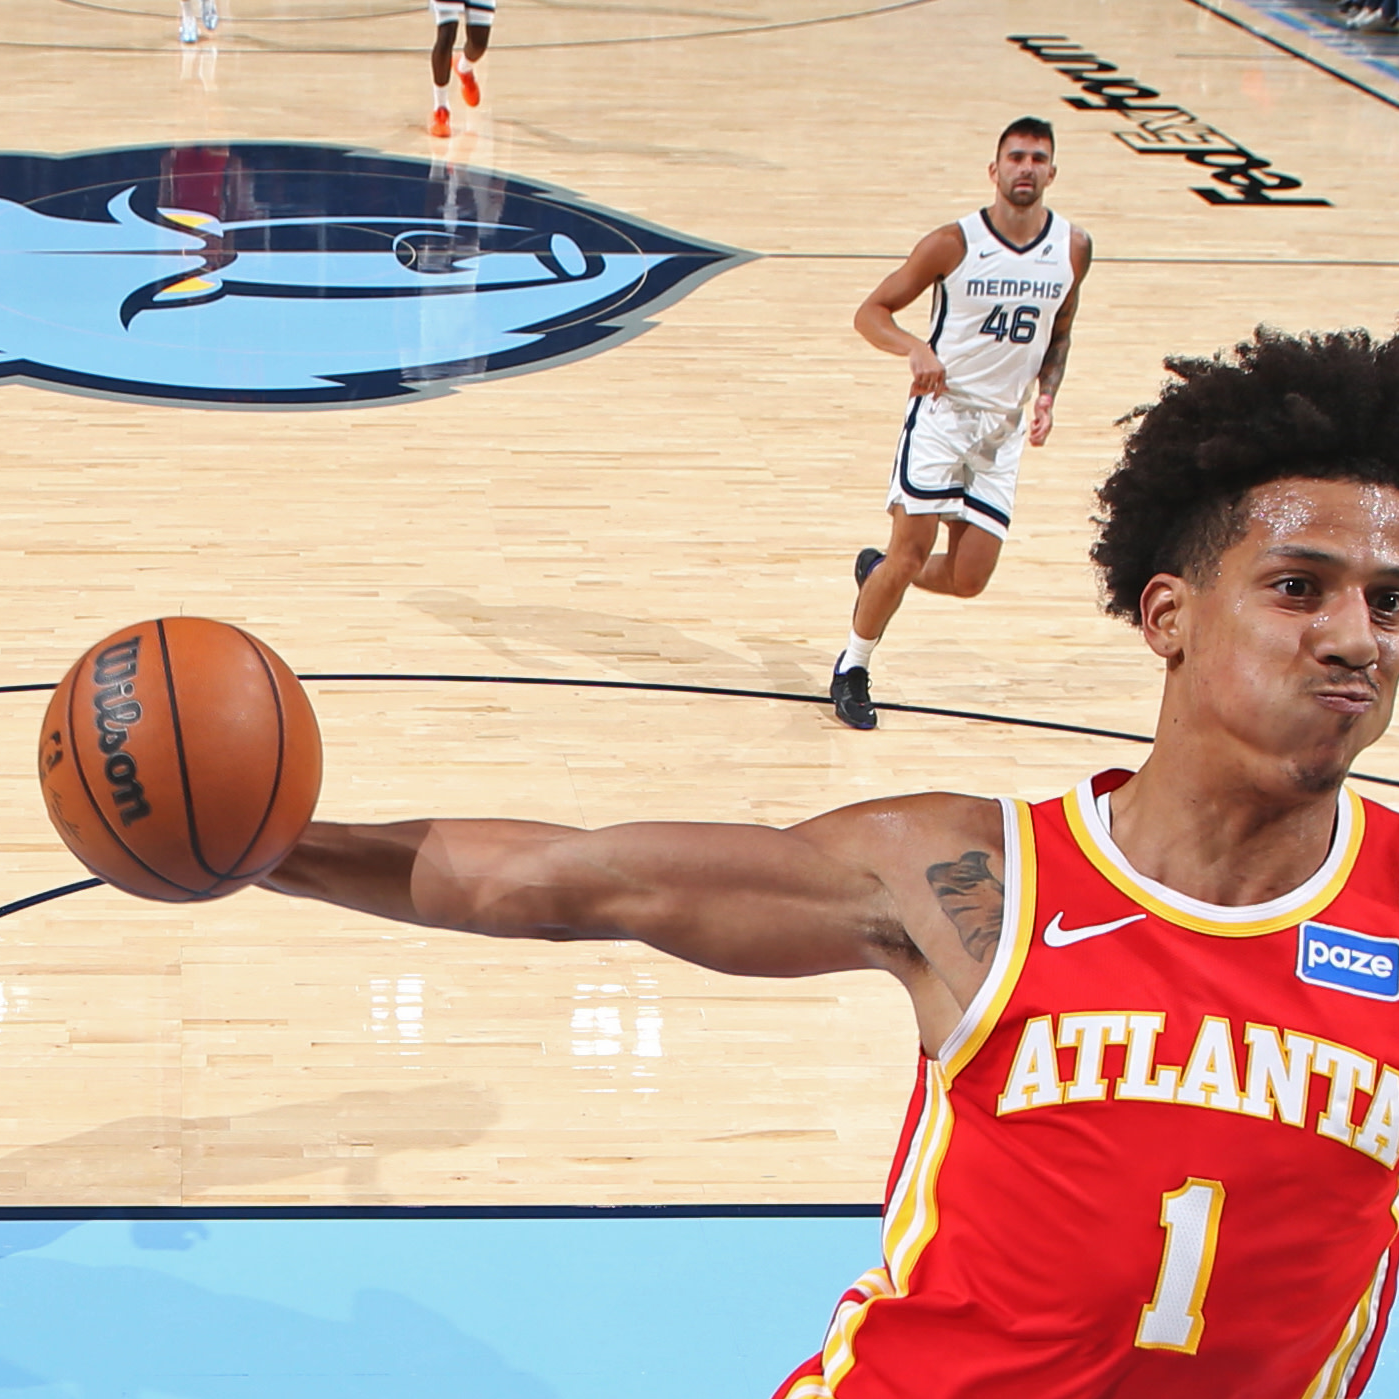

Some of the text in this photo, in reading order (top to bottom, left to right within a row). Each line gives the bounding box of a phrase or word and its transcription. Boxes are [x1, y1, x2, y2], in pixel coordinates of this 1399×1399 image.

[966, 278, 1063, 299] MEMPHIS
[979, 304, 1040, 344] 46
[92, 635, 152, 829] Wilson
[1308, 937, 1394, 980] paze
[1134, 1176, 1226, 1355] 1
